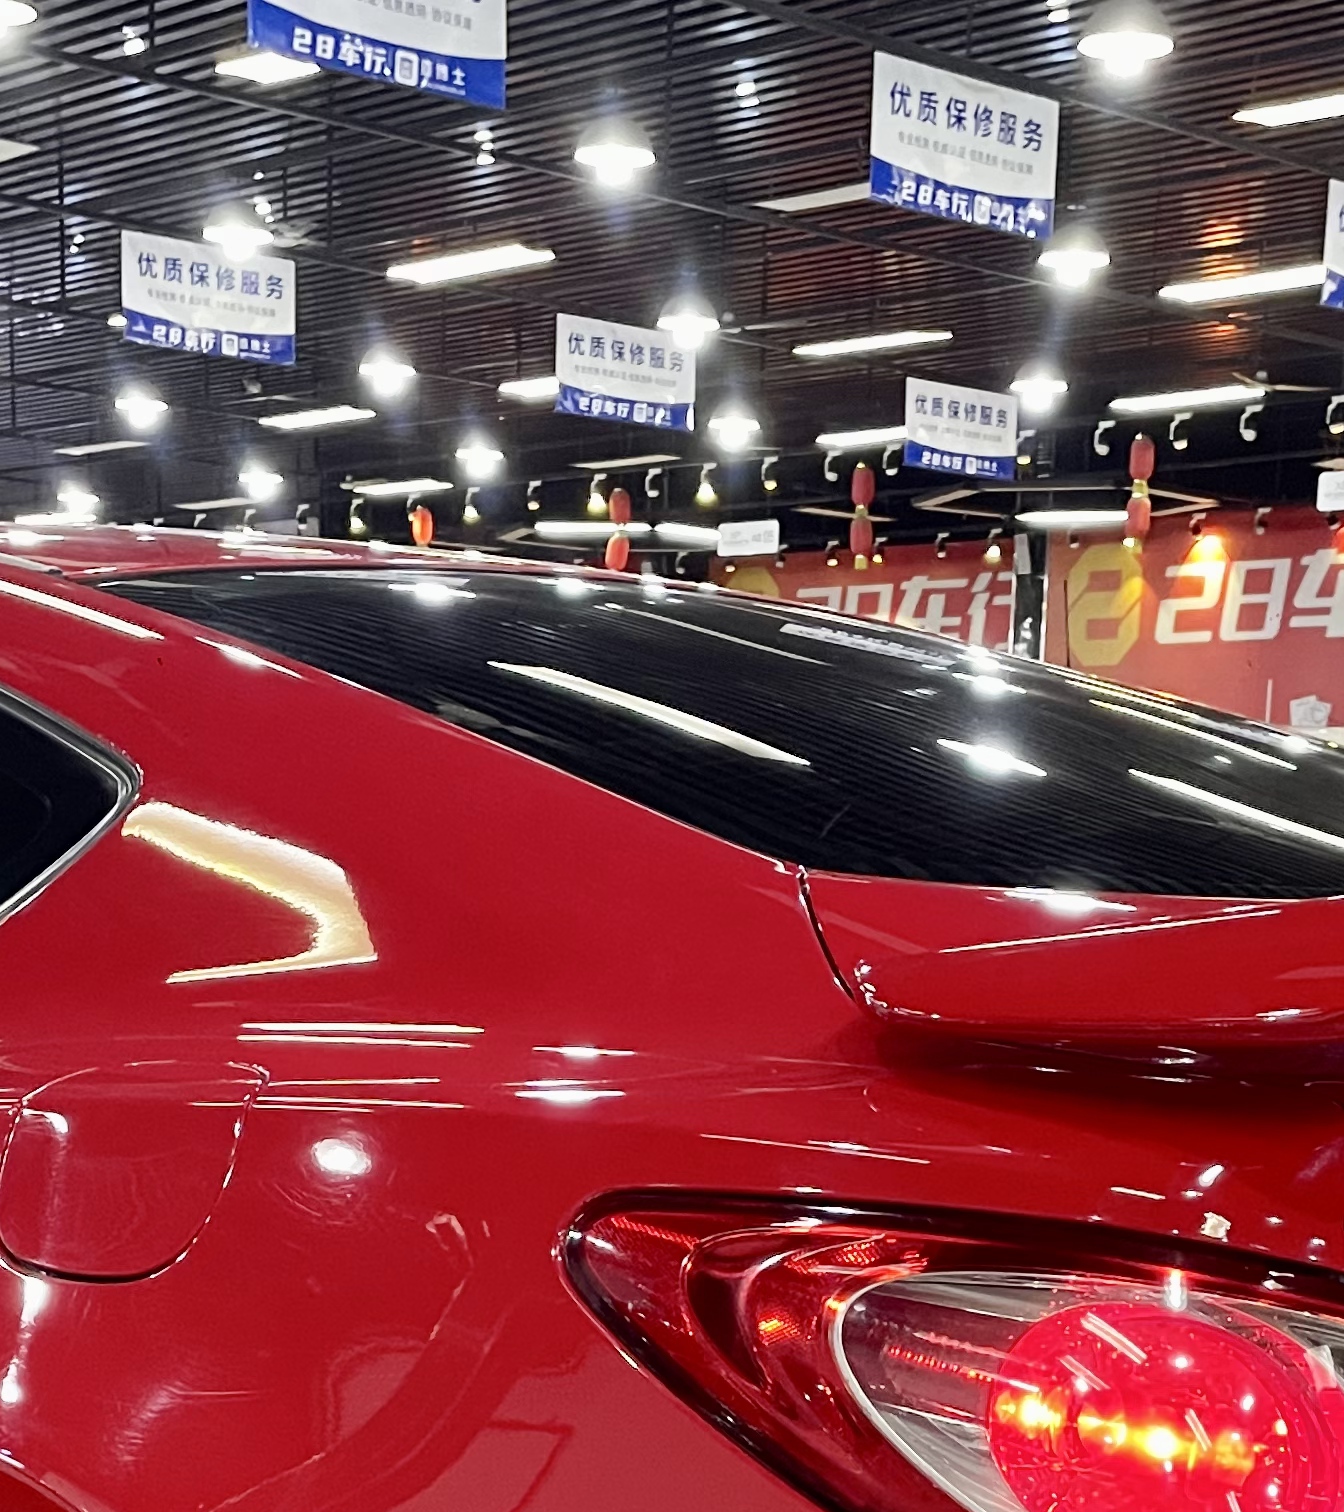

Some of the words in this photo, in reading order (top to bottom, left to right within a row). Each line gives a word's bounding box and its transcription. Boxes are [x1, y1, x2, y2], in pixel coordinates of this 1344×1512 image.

[292, 26, 387, 75] 28车行
[890, 81, 1043, 152] 优质保修服务
[902, 181, 969, 215] 28车行
[138, 252, 284, 299] 优质保修服务
[568, 332, 684, 372] 优质保修服务
